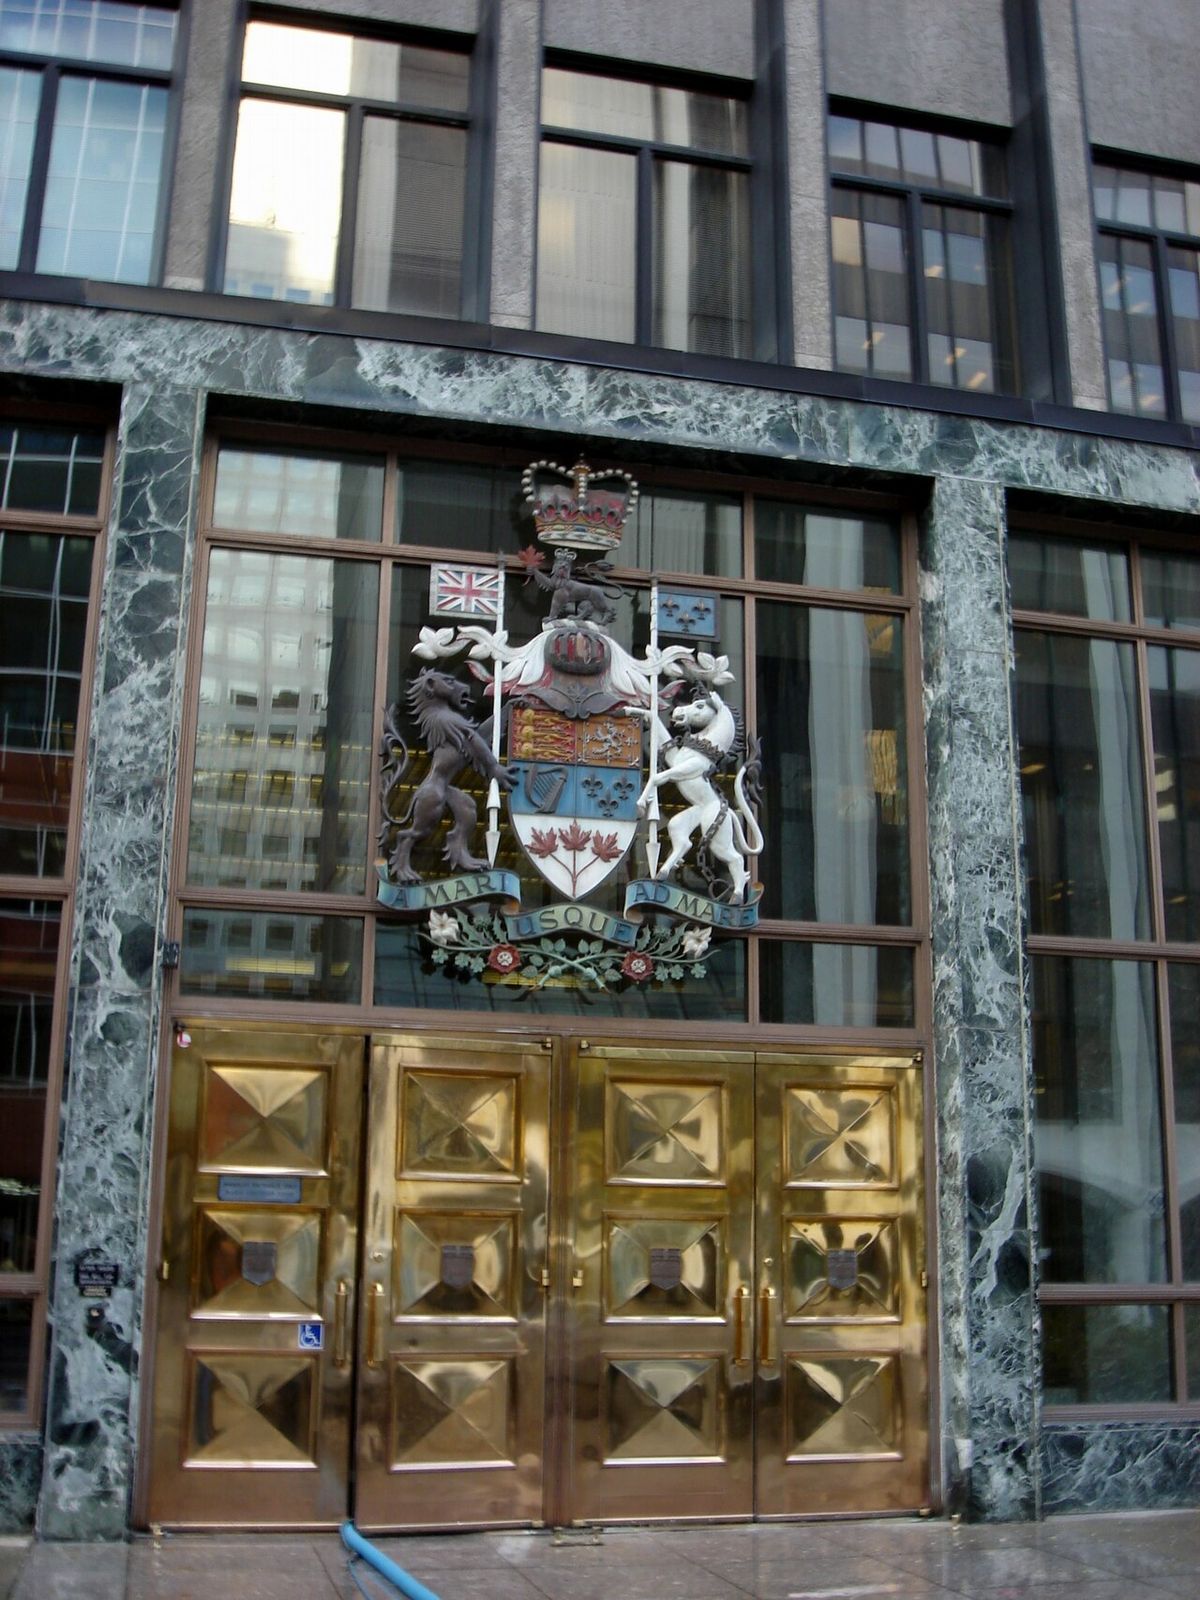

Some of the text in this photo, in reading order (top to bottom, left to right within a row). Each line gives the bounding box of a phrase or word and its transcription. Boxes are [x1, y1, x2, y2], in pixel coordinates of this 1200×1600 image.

[393, 873, 508, 908] A MARI
[633, 882, 755, 928] AD MARE
[515, 907, 634, 944] USQUE
